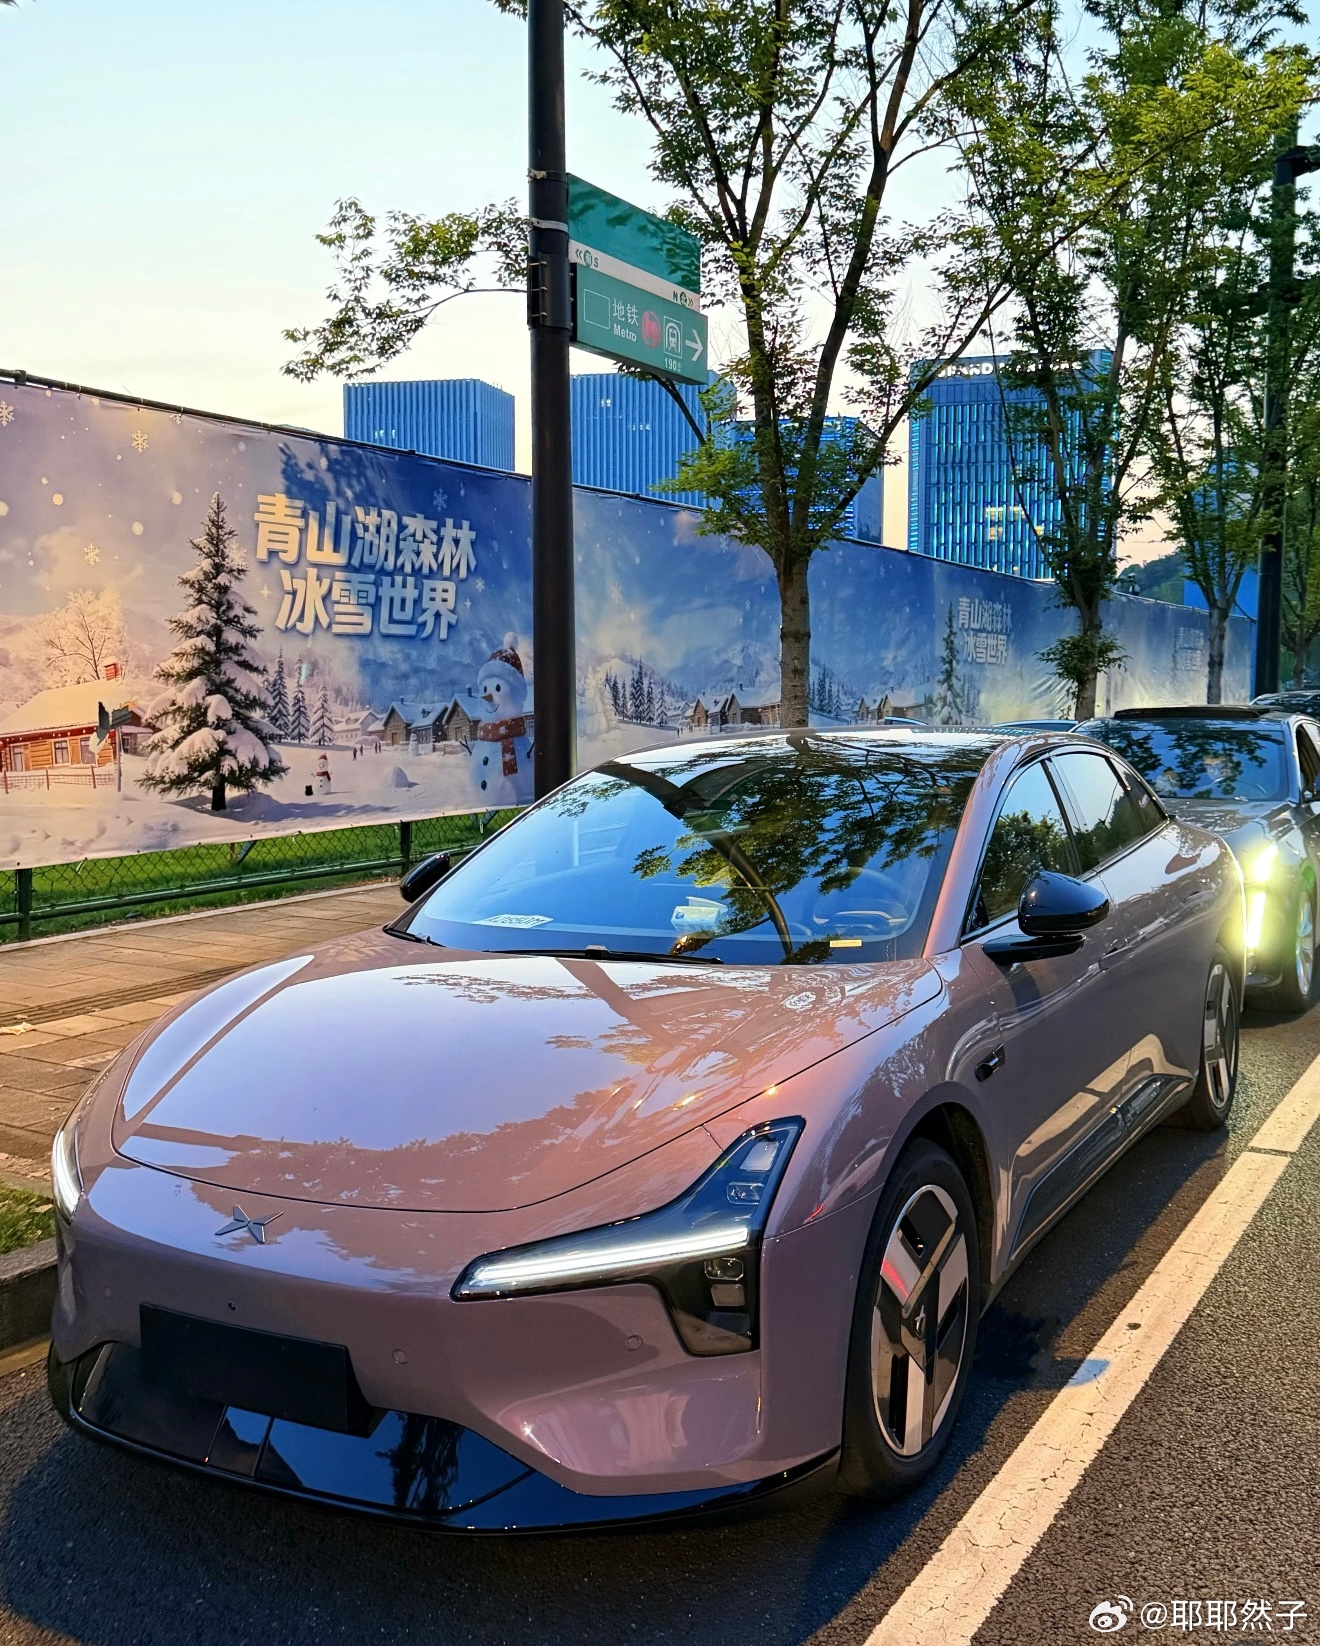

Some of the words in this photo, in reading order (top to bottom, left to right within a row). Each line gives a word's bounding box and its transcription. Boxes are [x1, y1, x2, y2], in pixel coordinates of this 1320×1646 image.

[594, 257, 599, 268] S
[673, 291, 678, 302] N
[612, 298, 639, 326] 地铁
[613, 323, 637, 343] Metro
[664, 357, 677, 372] 190
[254, 493, 477, 579] 青山湖森林
[274, 568, 458, 641] 冰雪世界
[958, 596, 1012, 633] 青山湖森林
[963, 630, 1008, 665] 冰雪世界
